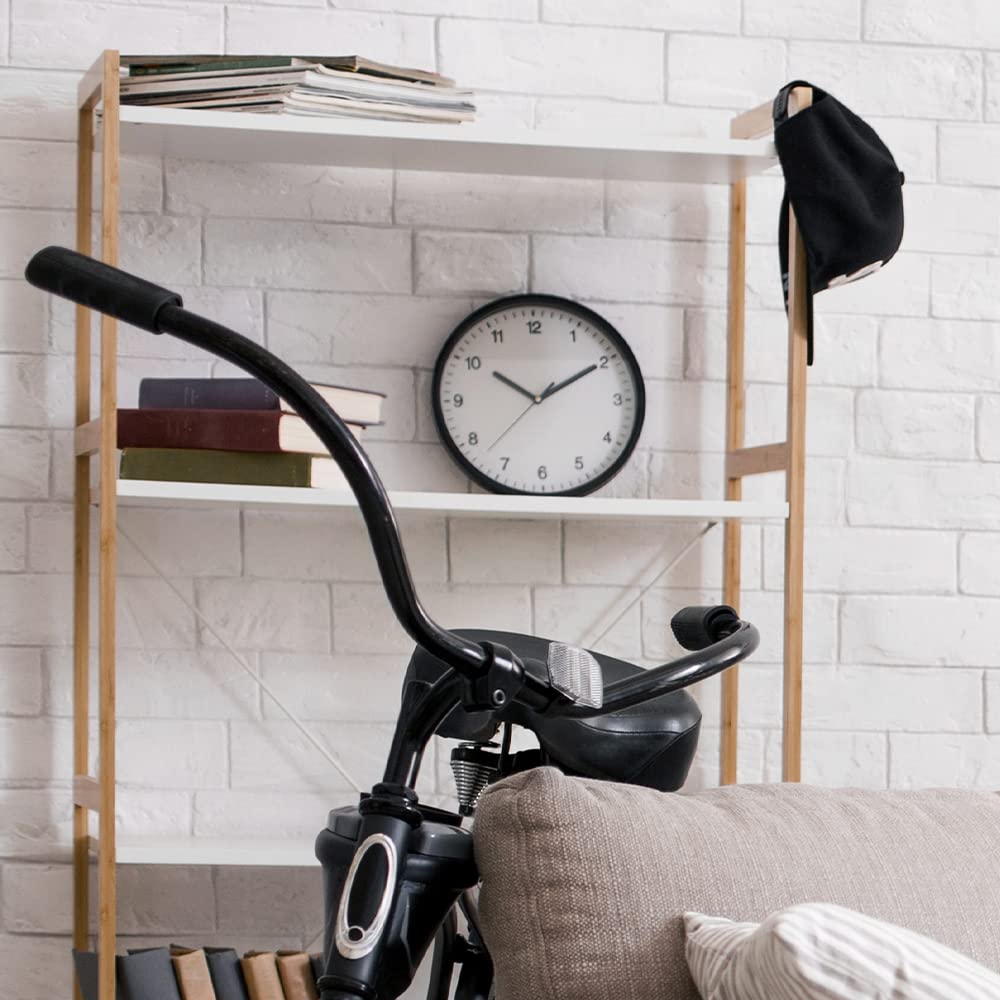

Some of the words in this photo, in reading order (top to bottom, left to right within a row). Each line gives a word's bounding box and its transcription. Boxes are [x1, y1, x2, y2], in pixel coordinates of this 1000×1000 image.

[526, 320, 542, 335] 12
[491, 329, 504, 344] 11
[569, 329, 577, 343] 1
[465, 355, 482, 370] 10
[599, 355, 609, 370] 2
[453, 393, 464, 408] 9
[612, 393, 623, 407] 3
[468, 431, 479, 446] 8
[602, 431, 612, 444] 4
[499, 456, 510, 471] 7
[573, 456, 584, 470] 5
[537, 465, 548, 480] 6
